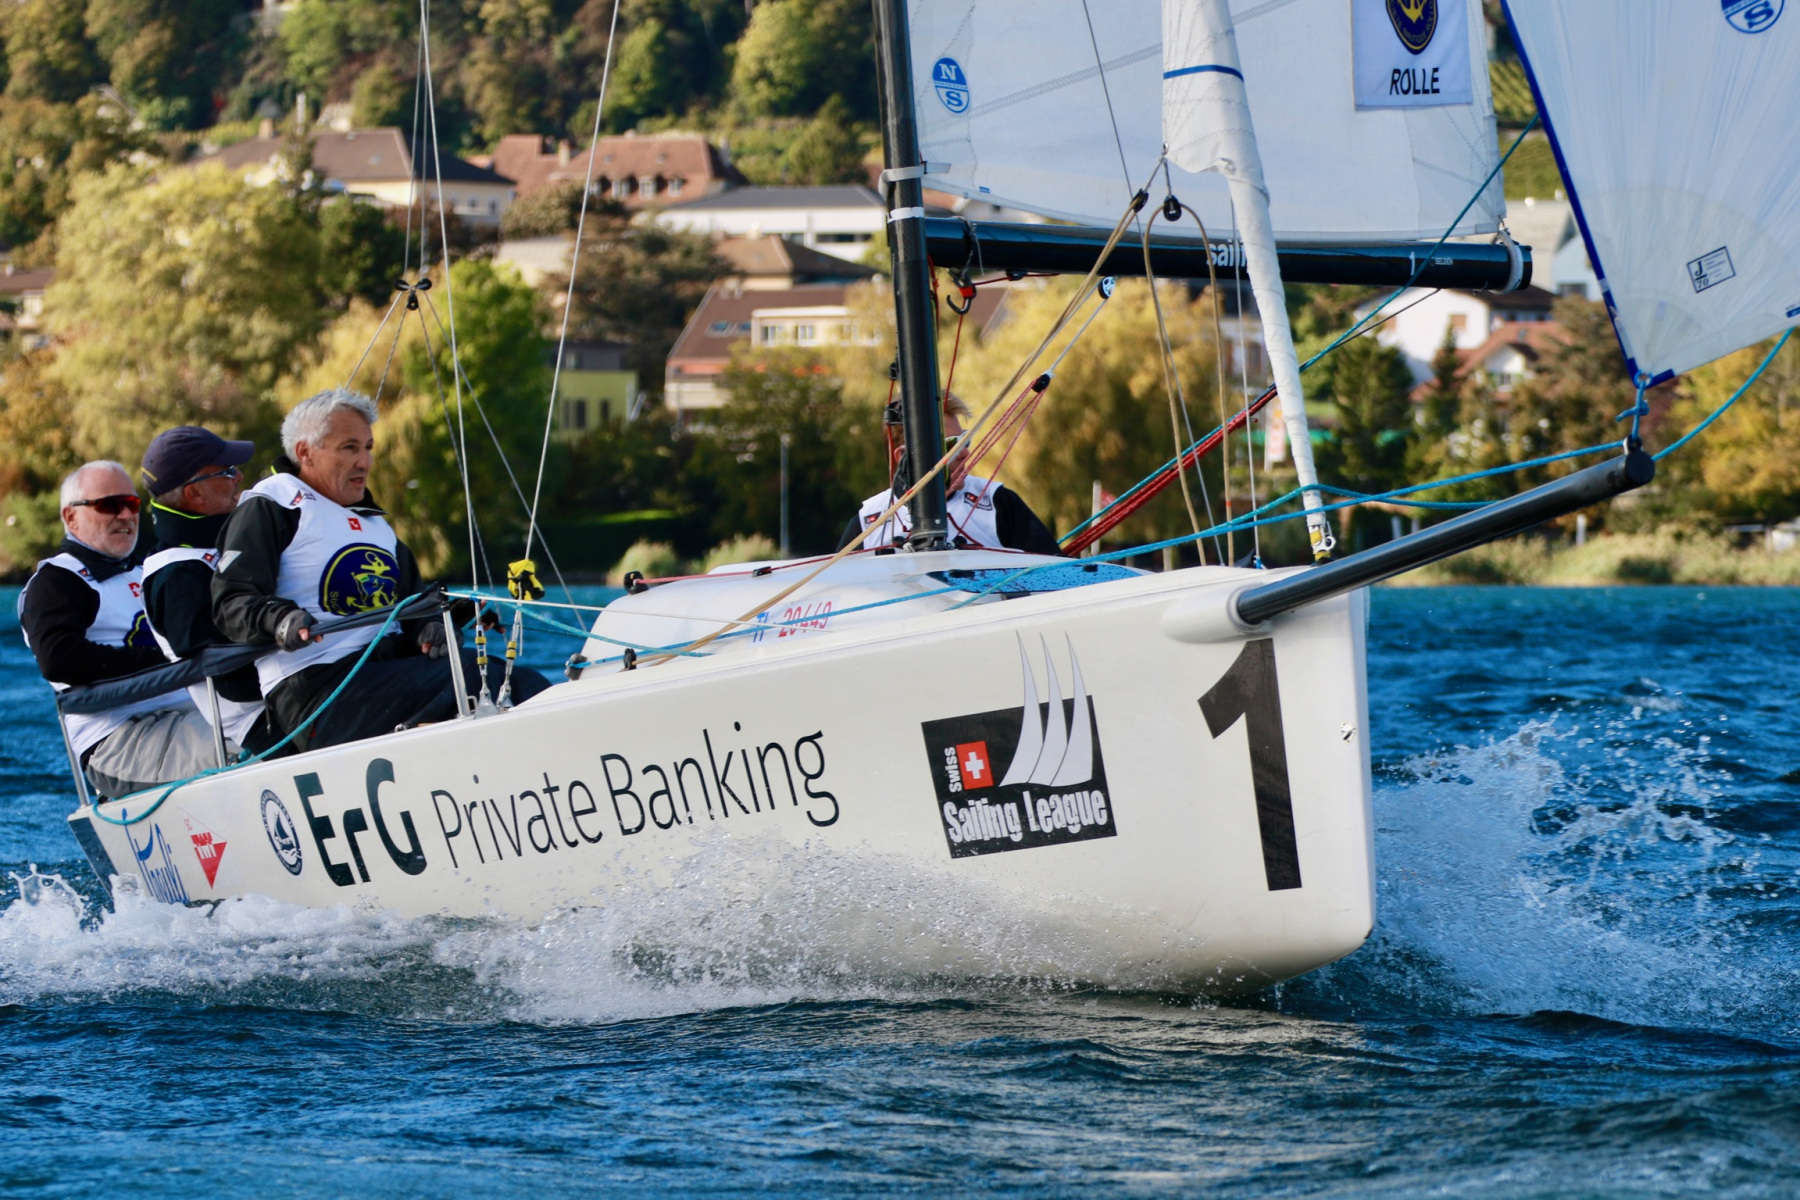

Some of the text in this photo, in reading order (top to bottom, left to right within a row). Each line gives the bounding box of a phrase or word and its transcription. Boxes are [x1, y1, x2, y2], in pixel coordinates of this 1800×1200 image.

[938, 63, 957, 81] N
[1389, 67, 1440, 95] ROLLE
[945, 91, 963, 107] S
[1197, 638, 1302, 890] 1
[431, 774, 603, 869] Private
[600, 721, 840, 836] Banking
[943, 790, 1108, 843] Sailing League
